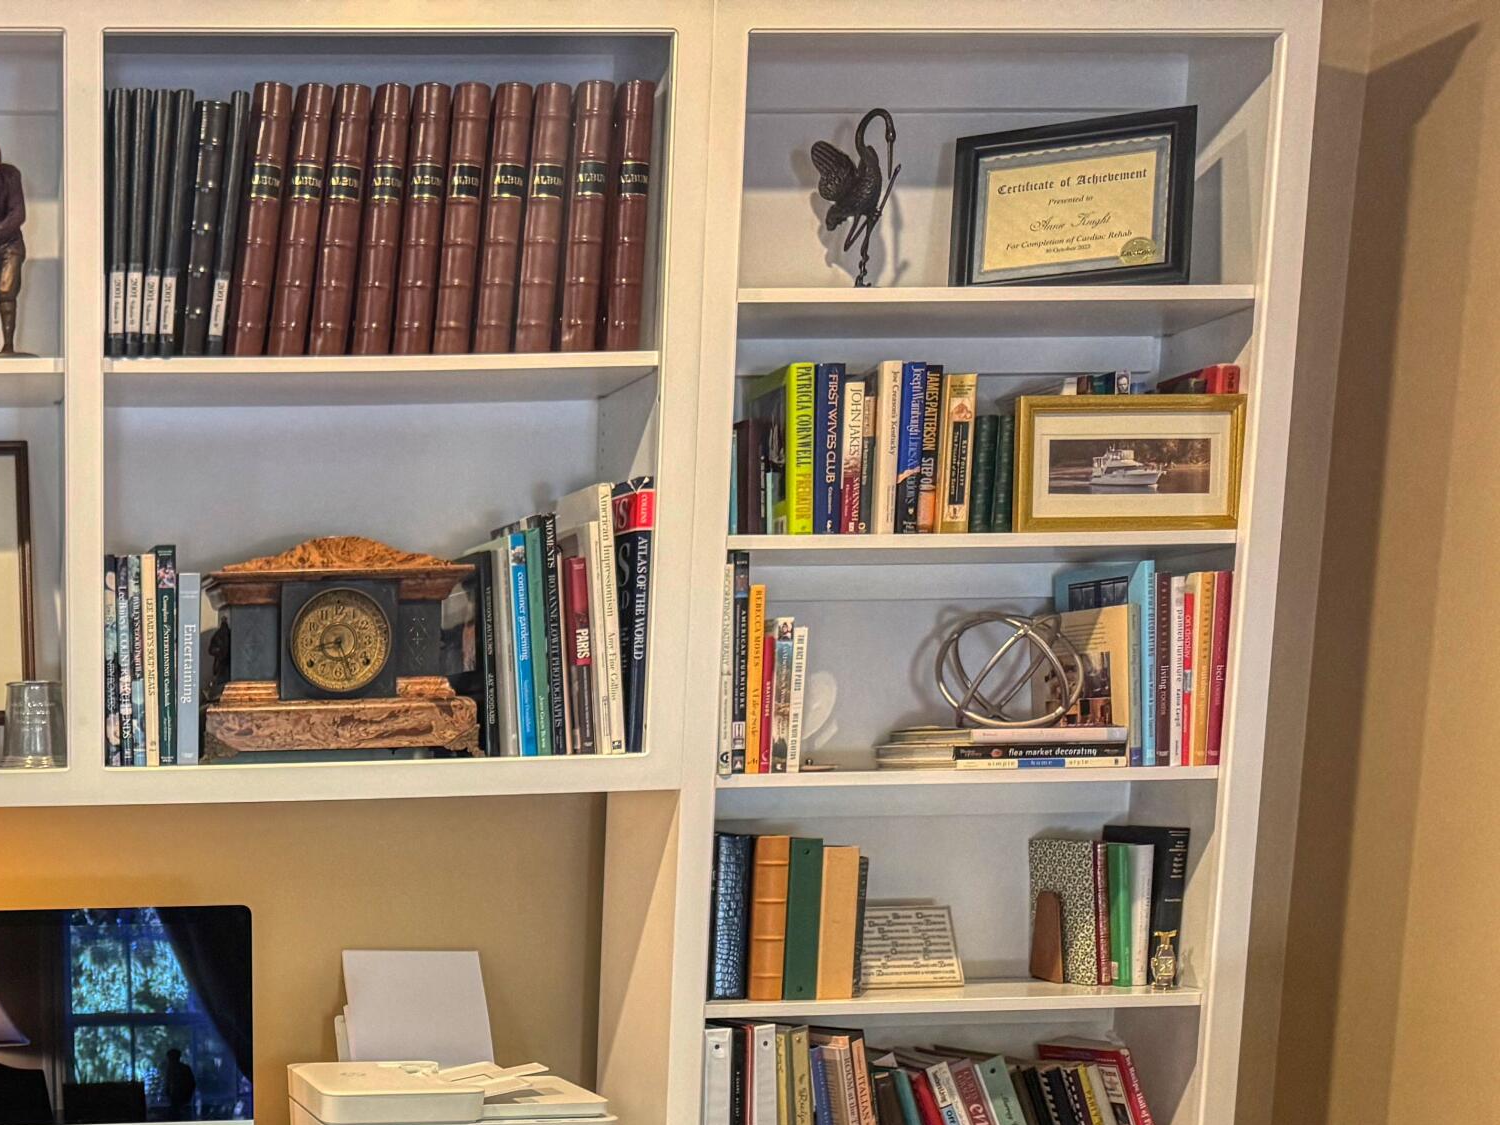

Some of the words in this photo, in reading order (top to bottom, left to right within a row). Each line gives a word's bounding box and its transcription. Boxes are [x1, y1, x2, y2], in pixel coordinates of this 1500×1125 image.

[997, 180, 1054, 195] Certificate
[1060, 176, 1070, 187] of
[1075, 168, 1148, 186] Achievement
[1020, 238, 1064, 249] Completion
[1075, 233, 1106, 242] Cardiac
[795, 366, 811, 411] PATRICIA
[826, 373, 838, 406] FIRST
[911, 366, 926, 391] Joseph
[925, 371, 940, 400] JAMES
[850, 388, 862, 421] JOHN
[890, 384, 900, 418] Creason's
[907, 392, 924, 436] Wambaugh
[795, 414, 811, 467] CORNWELL
[826, 407, 838, 450] WIVES
[849, 424, 861, 456] JAKES
[888, 421, 899, 455] Kentucky
[922, 401, 937, 450] PATTERSON
[825, 451, 837, 483] CLUB
[921, 457, 935, 477] STEP
[795, 473, 811, 519] PREDATOR
[600, 494, 611, 540] American
[544, 520, 556, 568] MOMENTS
[636, 537, 648, 576] ATLAS
[517, 572, 527, 614] container
[547, 574, 559, 620] ROXANNE
[602, 544, 614, 617] Impressionism
[636, 577, 647, 591] OF
[146, 598, 155, 612] LEE
[634, 592, 646, 616] THE
[146, 614, 155, 647] BAILEY'S
[518, 616, 530, 661] gardening
[575, 628, 590, 659] PARIS
[606, 632, 616, 649] Amy
[633, 618, 645, 660] WORLD
[1183, 626, 1192, 658] display
[181, 624, 197, 704] Entertaining
[608, 652, 617, 670] Fine
[1158, 665, 1168, 689] living
[147, 669, 156, 696] MEALS
[610, 672, 619, 701] Collins
[1008, 748, 1024, 757] flea
[1055, 747, 1097, 757] decorating
[843, 1057, 855, 1090] ROOM
[848, 1102, 857, 1116] the
[857, 1073, 870, 1120] ITALIAN
[1137, 1091, 1146, 1108] Hall
[945, 1109, 958, 1124] Off
